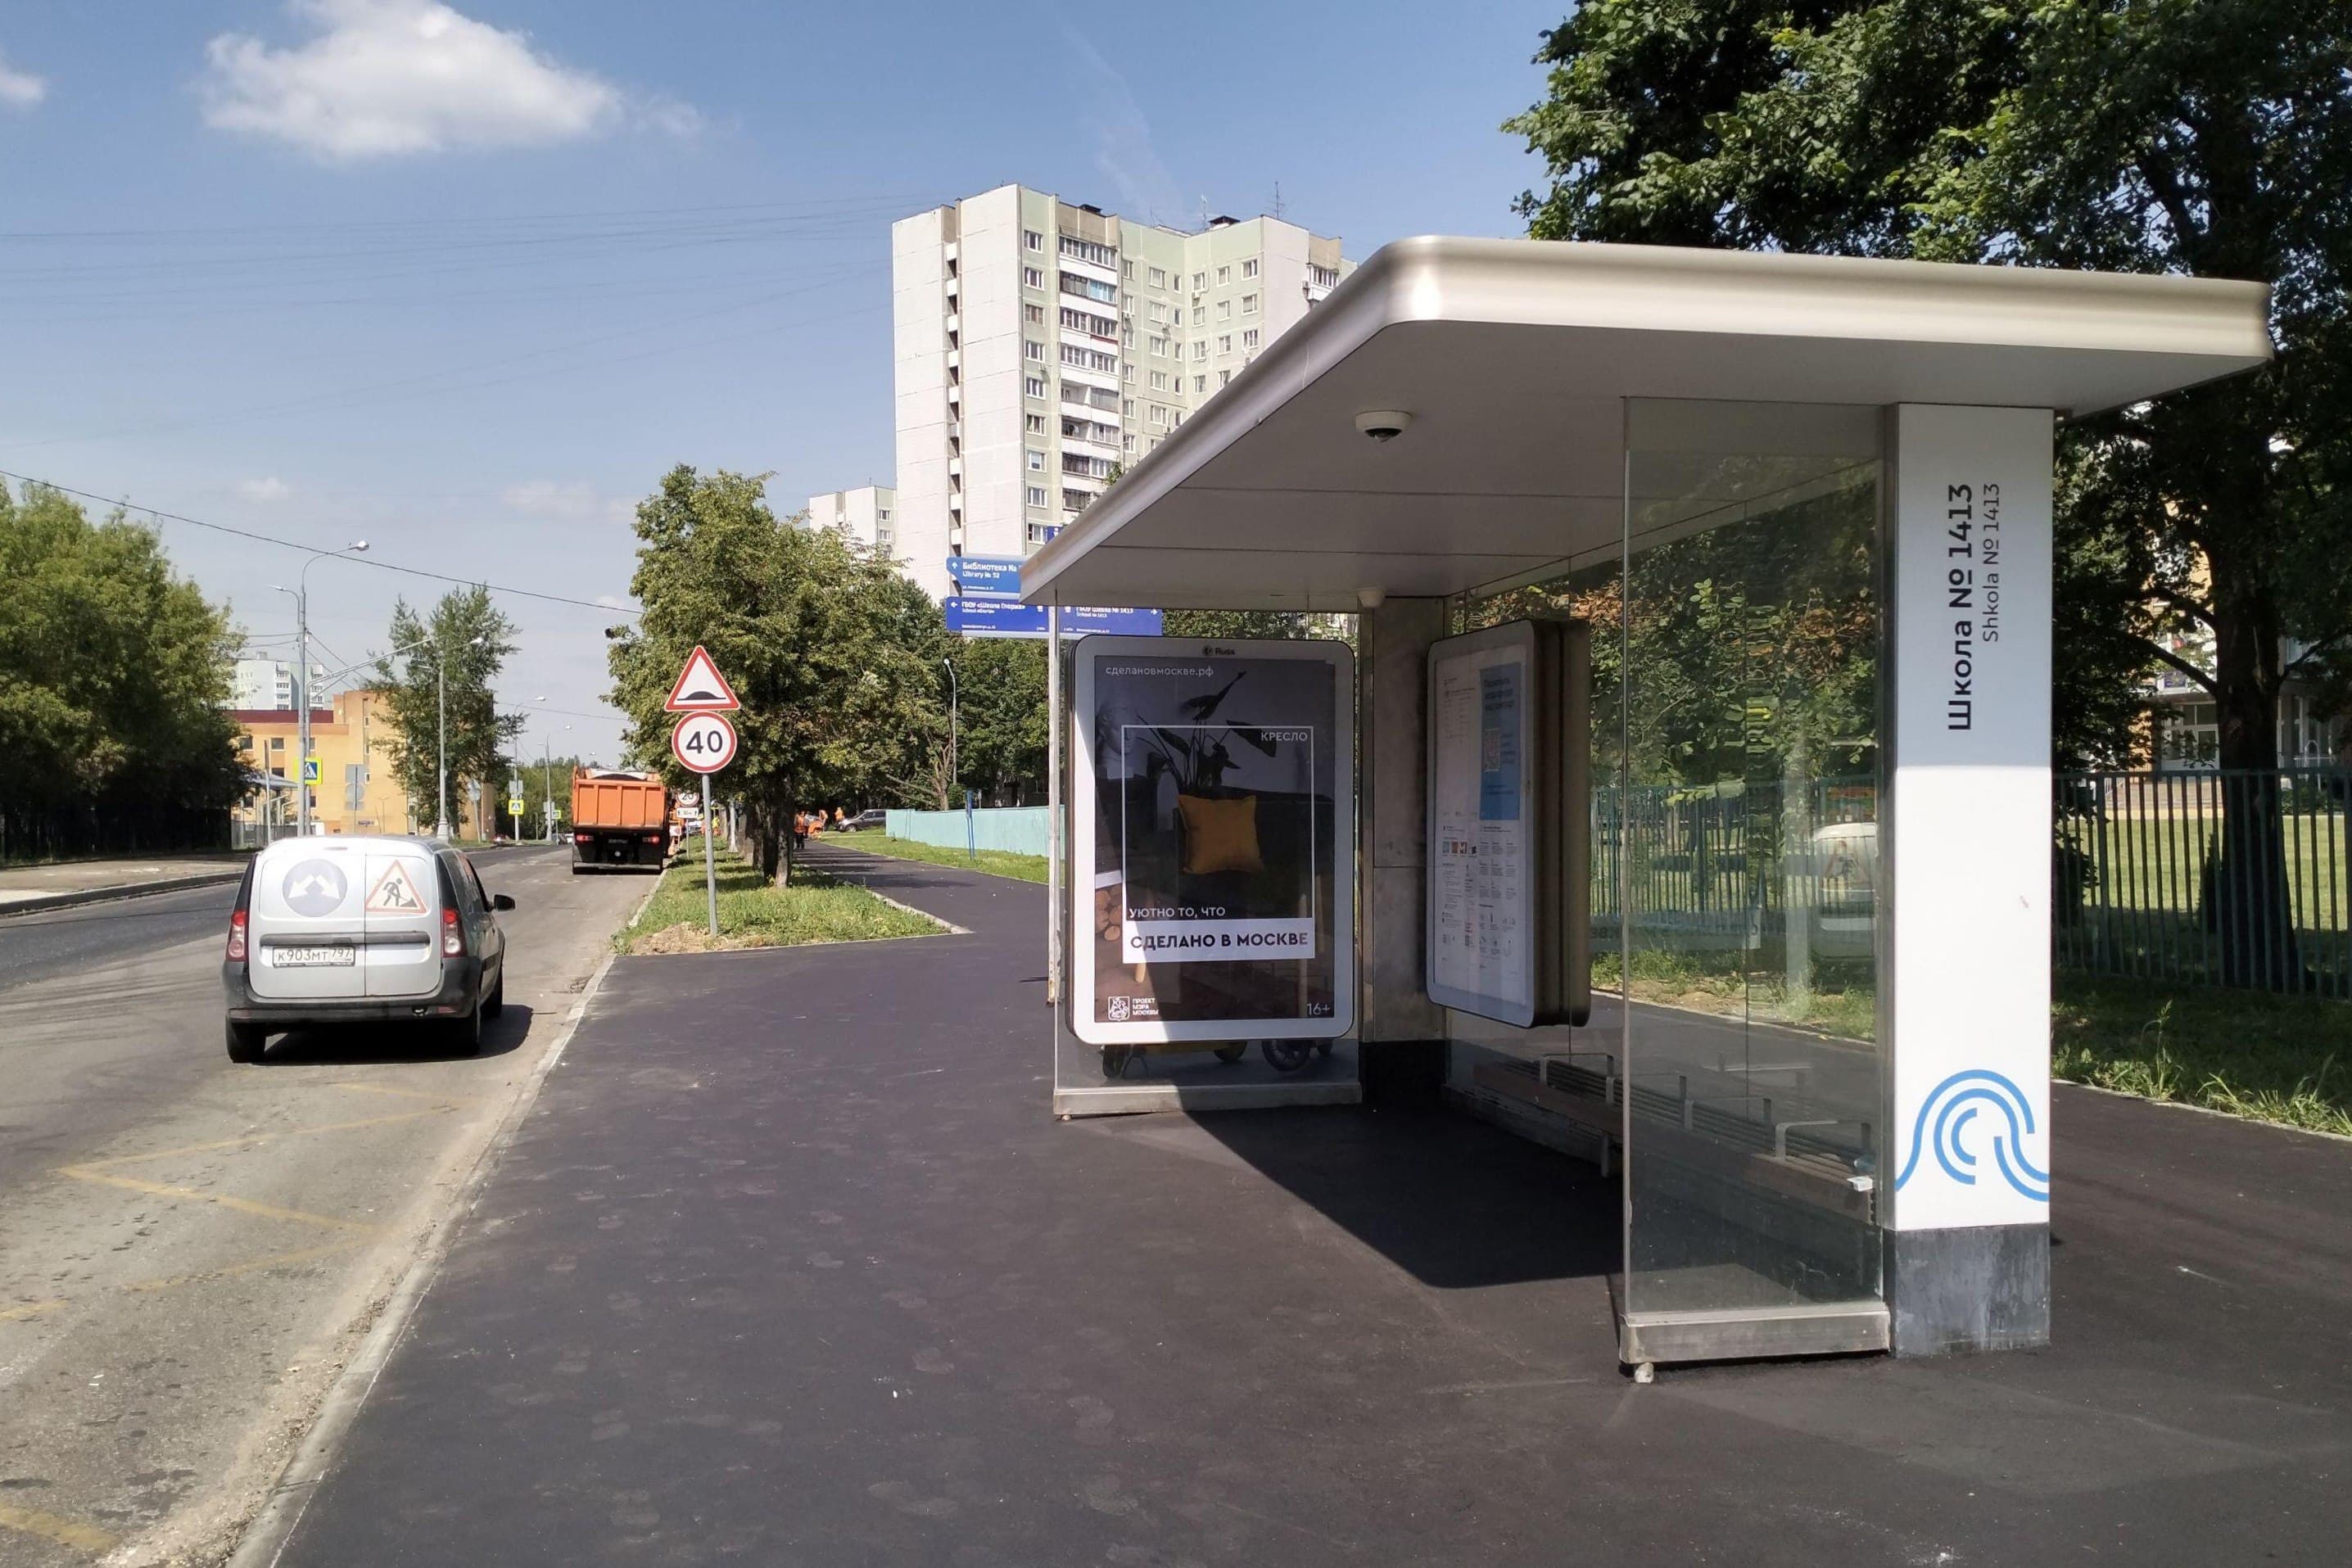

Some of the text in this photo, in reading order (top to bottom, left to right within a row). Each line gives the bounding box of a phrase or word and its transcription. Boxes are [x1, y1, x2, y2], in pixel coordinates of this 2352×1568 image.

[962, 562, 1007, 572] Библиотека
[1982, 483, 1999, 643] Shkola № 1413
[962, 571, 984, 580] Library
[1948, 483, 1972, 730] Школа № 1413
[1106, 666, 1214, 677] сделановмоскве.рф
[685, 730, 723, 754] 40
[1261, 732, 1308, 741] КРЕСЛО
[1129, 906, 1226, 919] УЮТНО ТО, ЧТО
[1130, 933, 1308, 951] СДЕЛАНО В МОСКВЕ
[278, 949, 328, 961] К903МТ
[1306, 1002, 1331, 1016] 16+
